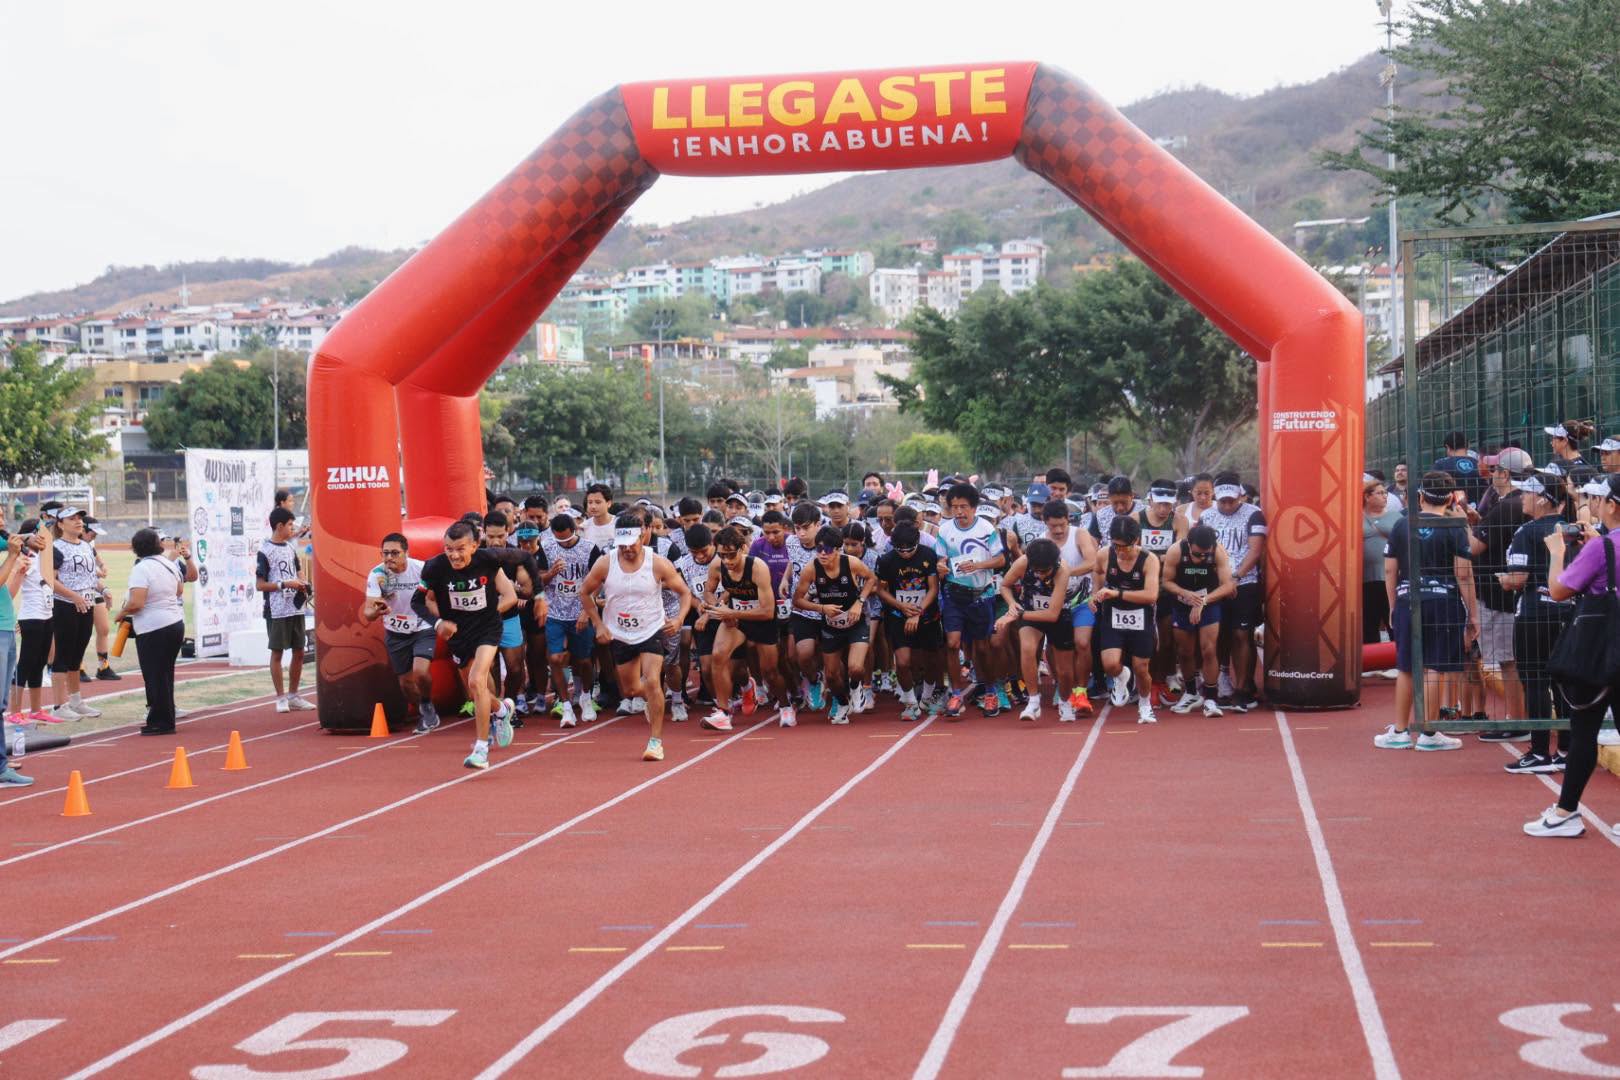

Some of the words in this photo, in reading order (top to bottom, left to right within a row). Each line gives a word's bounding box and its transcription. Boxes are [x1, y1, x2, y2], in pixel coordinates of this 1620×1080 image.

[652, 69, 1007, 130] LLEGASTE
[673, 121, 988, 158] ¡ENHORABUENA!
[1273, 411, 1336, 419] CONSTRUYENDO
[205, 459, 246, 483] AUTISMO
[327, 465, 389, 482] ZIHUA
[1144, 535, 1165, 545] 167
[557, 582, 577, 593] 054
[453, 597, 479, 607] 184
[390, 618, 409, 630] 276
[617, 617, 639, 628] 053
[1115, 613, 1136, 625] 163
[190, 1009, 458, 1080] 5
[623, 1005, 846, 1079] 6
[1062, 1006, 1250, 1079] 7
